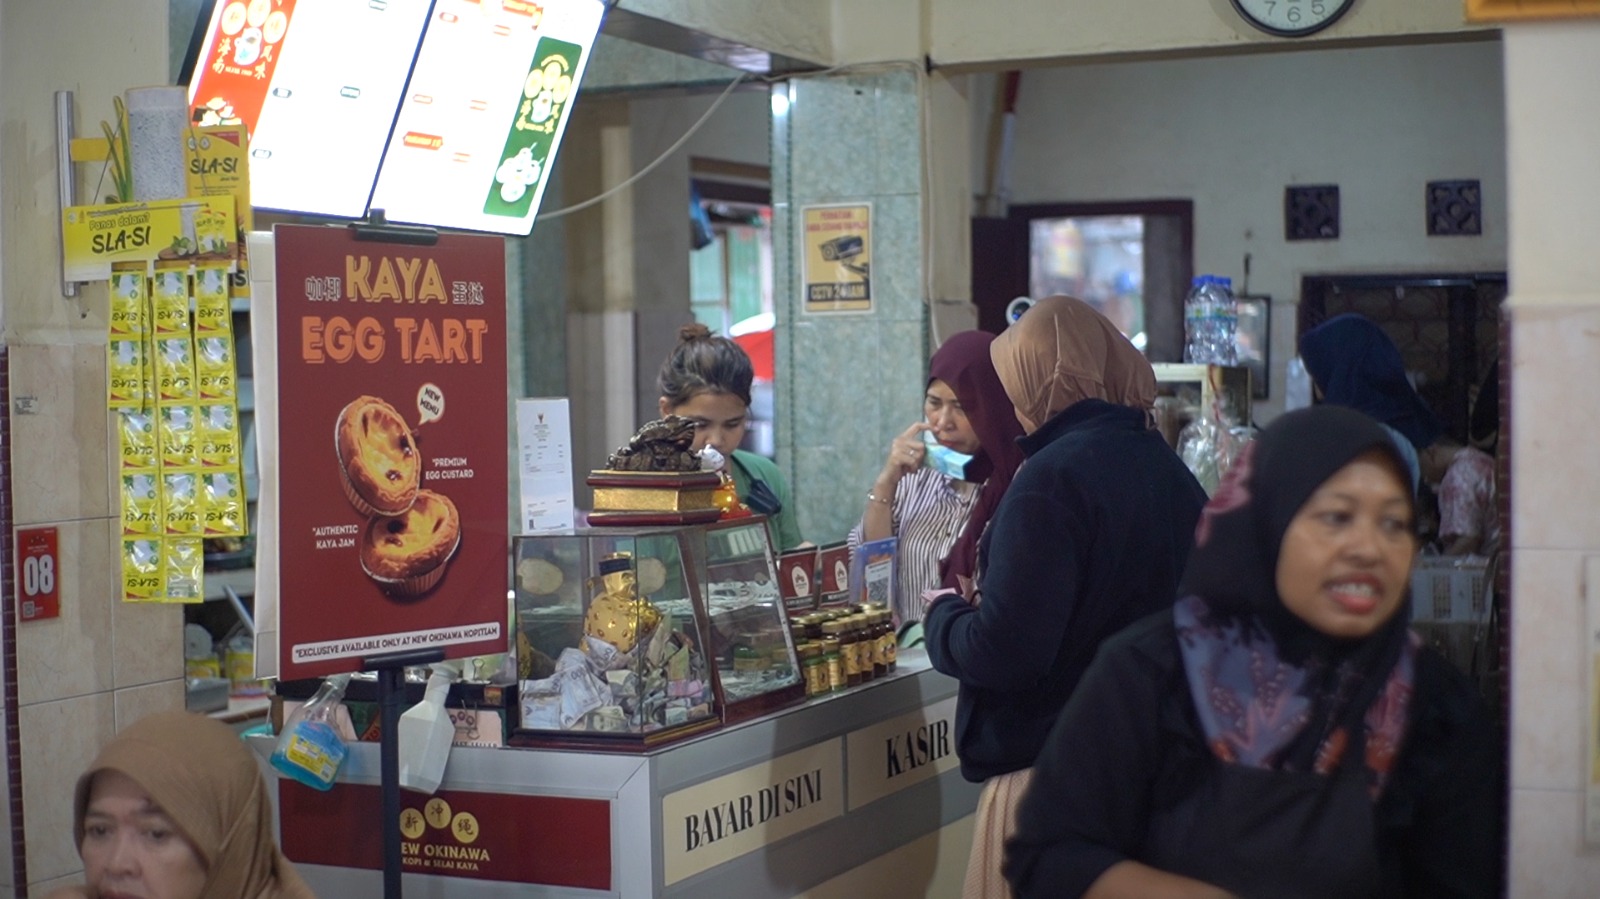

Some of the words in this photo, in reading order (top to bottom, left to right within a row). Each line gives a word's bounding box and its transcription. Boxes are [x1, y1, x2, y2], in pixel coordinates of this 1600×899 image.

[1264, 1, 1277, 16] 7
[1287, 6, 1302, 23] 6
[1311, 0, 1325, 15] 5
[190, 157, 239, 175] SLA-SI
[89, 216, 116, 231] Panas
[118, 211, 151, 227] dalam?
[91, 226, 152, 254] SLA-SI
[345, 255, 448, 304] KAYA
[302, 316, 386, 364] EGG
[394, 317, 489, 364] TART
[424, 387, 441, 403] NEW
[419, 398, 440, 416] MENU
[425, 470, 441, 480] EGG
[441, 469, 475, 479] CUSTARD
[316, 539, 337, 549] KAYA
[338, 538, 355, 548] JAM
[23, 554, 54, 596] 08
[340, 640, 381, 653] AVAILABLE
[381, 637, 401, 649] ONLY
[402, 636, 411, 646] AT
[412, 635, 429, 645] NEW
[429, 631, 463, 643] OKINAWA
[463, 627, 497, 639] KOPITIAM
[886, 719, 950, 779] KASIR
[685, 794, 754, 852] BAYAR
[759, 783, 781, 825] DI
[784, 769, 822, 814] SINI
[401, 842, 420, 855] EW
[424, 844, 491, 862] OKINAWA
[402, 857, 422, 866] KOPI
[433, 859, 455, 869] SELAI
[456, 860, 479, 871] KAYA
